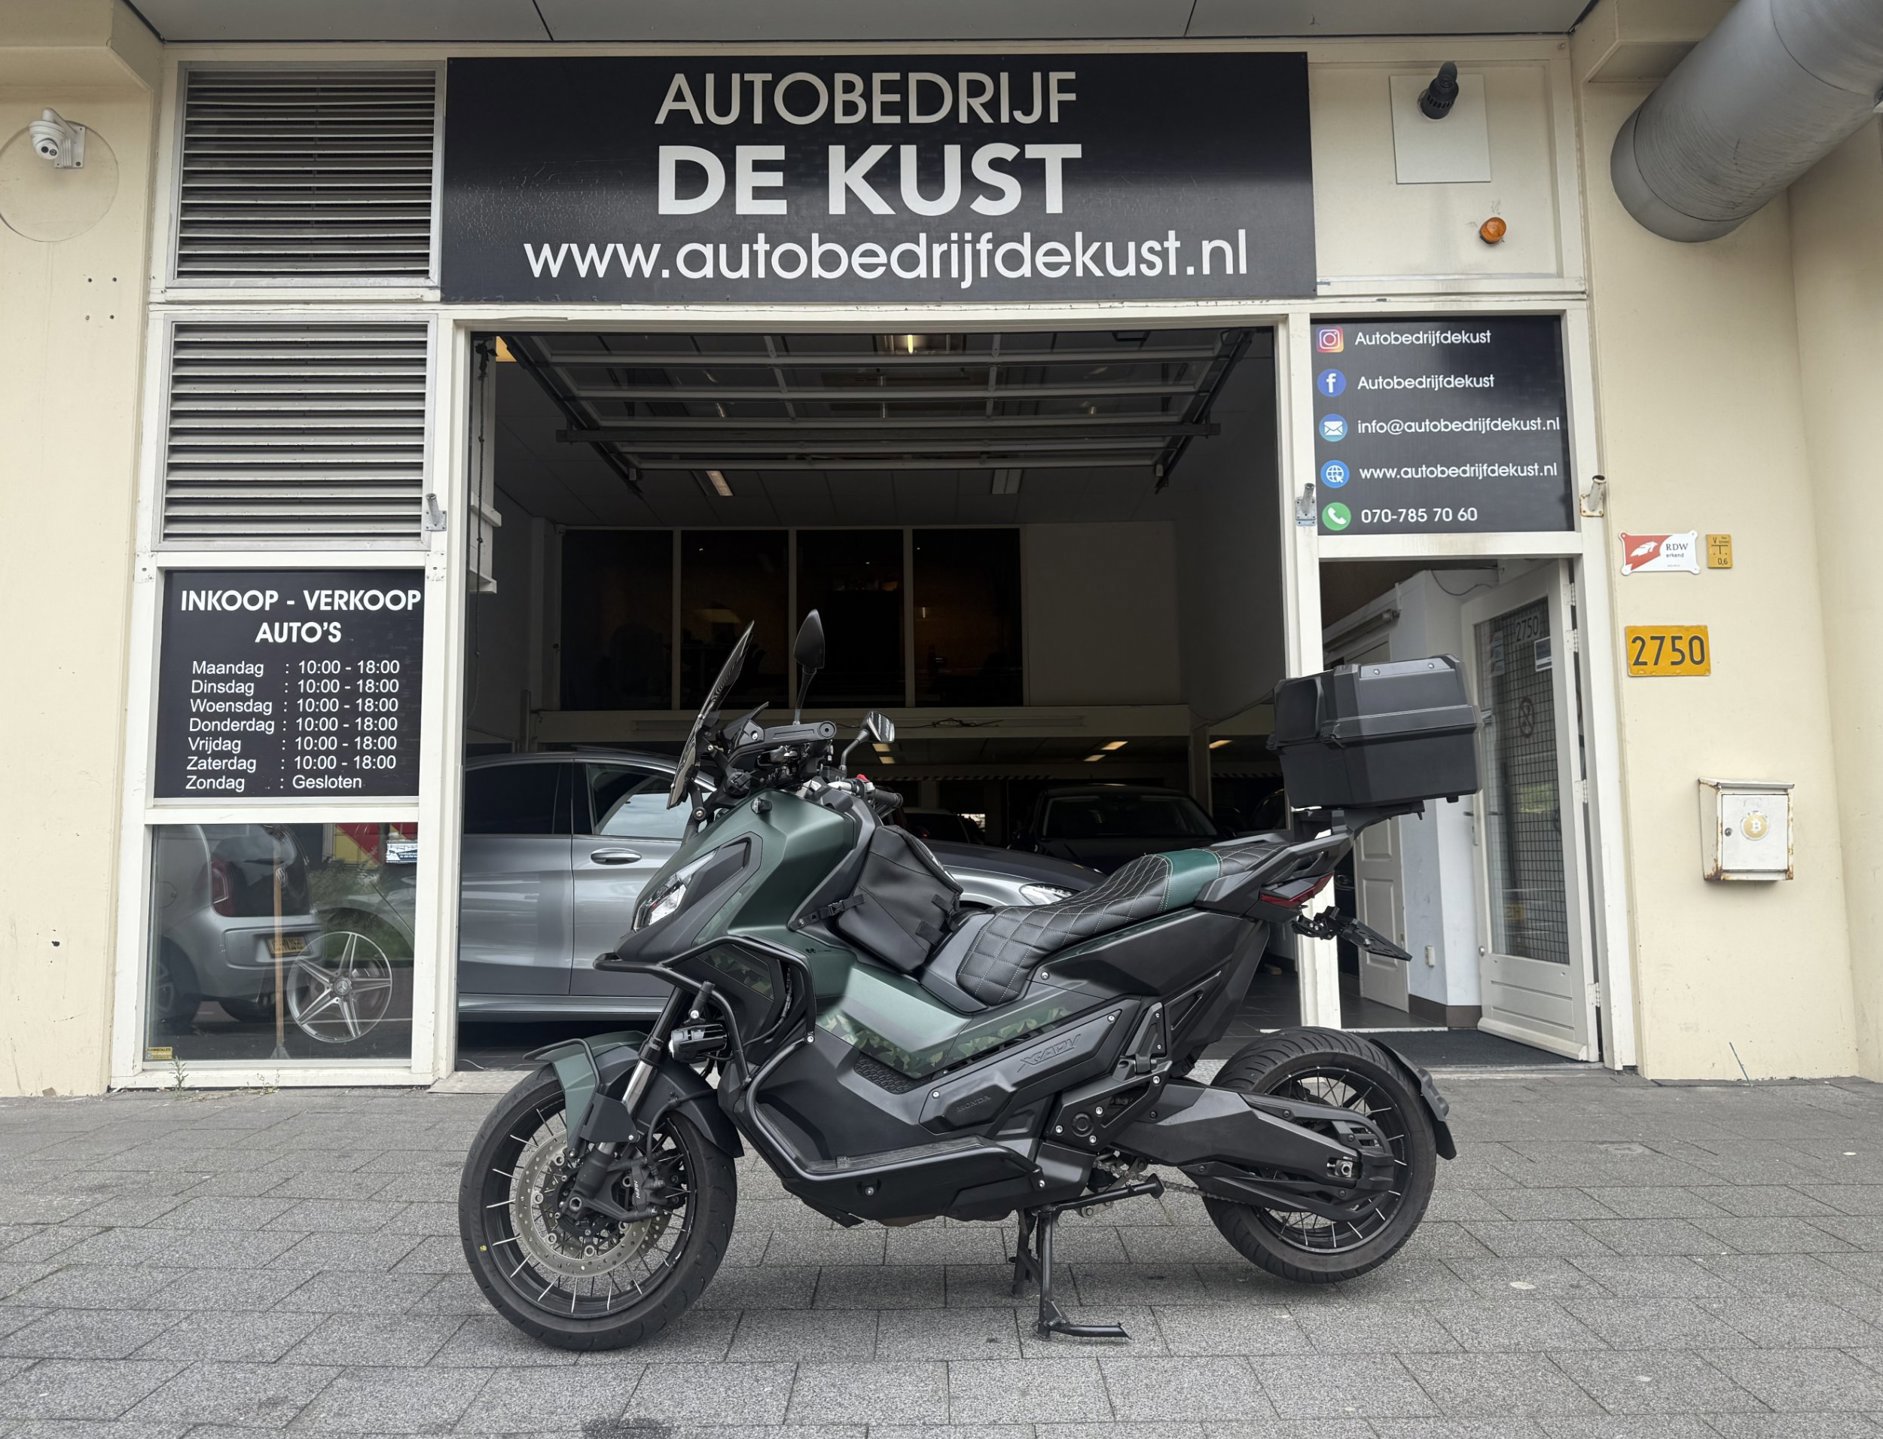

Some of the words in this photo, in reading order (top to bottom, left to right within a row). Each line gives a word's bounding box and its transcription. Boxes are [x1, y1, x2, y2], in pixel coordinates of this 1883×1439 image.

[654, 71, 1077, 126] AUTOBEDRIJF
[657, 144, 788, 216] DE
[828, 142, 1083, 217] KUST
[523, 228, 1248, 289] www.autobedrijfdekust.nl
[1354, 330, 1492, 347] Autobedrijfdekust
[1357, 374, 1495, 391] Autobedrijfdekust
[1357, 416, 1561, 436] info@autobedrijfdekust.nl
[1359, 462, 1558, 480] www.autobedrijfdekust.nl
[1361, 508, 1428, 524] 070-785
[1432, 507, 1453, 522] 70
[1457, 507, 1478, 522] 60
[1665, 543, 1688, 551] RDW
[181, 589, 279, 612] INKOOP
[302, 589, 422, 611] VERKOOP
[254, 621, 342, 643] AUTO'S
[1515, 615, 1539, 642] 2750
[1631, 635, 1706, 667] 2750
[192, 660, 264, 678] Maandag
[298, 659, 341, 675] 10:00
[357, 659, 400, 674] 18:00
[191, 679, 255, 697] Dinsdag
[297, 678, 340, 694] 10:00
[356, 678, 400, 693] 18:00
[190, 698, 273, 716] Woensdag
[296, 697, 340, 713] 10:00
[355, 697, 399, 712] 18:00
[189, 717, 275, 735] Donderdag
[295, 716, 339, 732] 10:00
[355, 716, 398, 731] 18:00
[187, 736, 242, 755] Vrijdag
[295, 736, 338, 751] 10:00
[354, 735, 398, 750] 18:00
[186, 755, 257, 774] Zaterdag
[294, 755, 337, 770] 10:00
[353, 754, 397, 770] 18:00
[185, 775, 245, 793] Zondag
[292, 774, 362, 789] Gesloten
